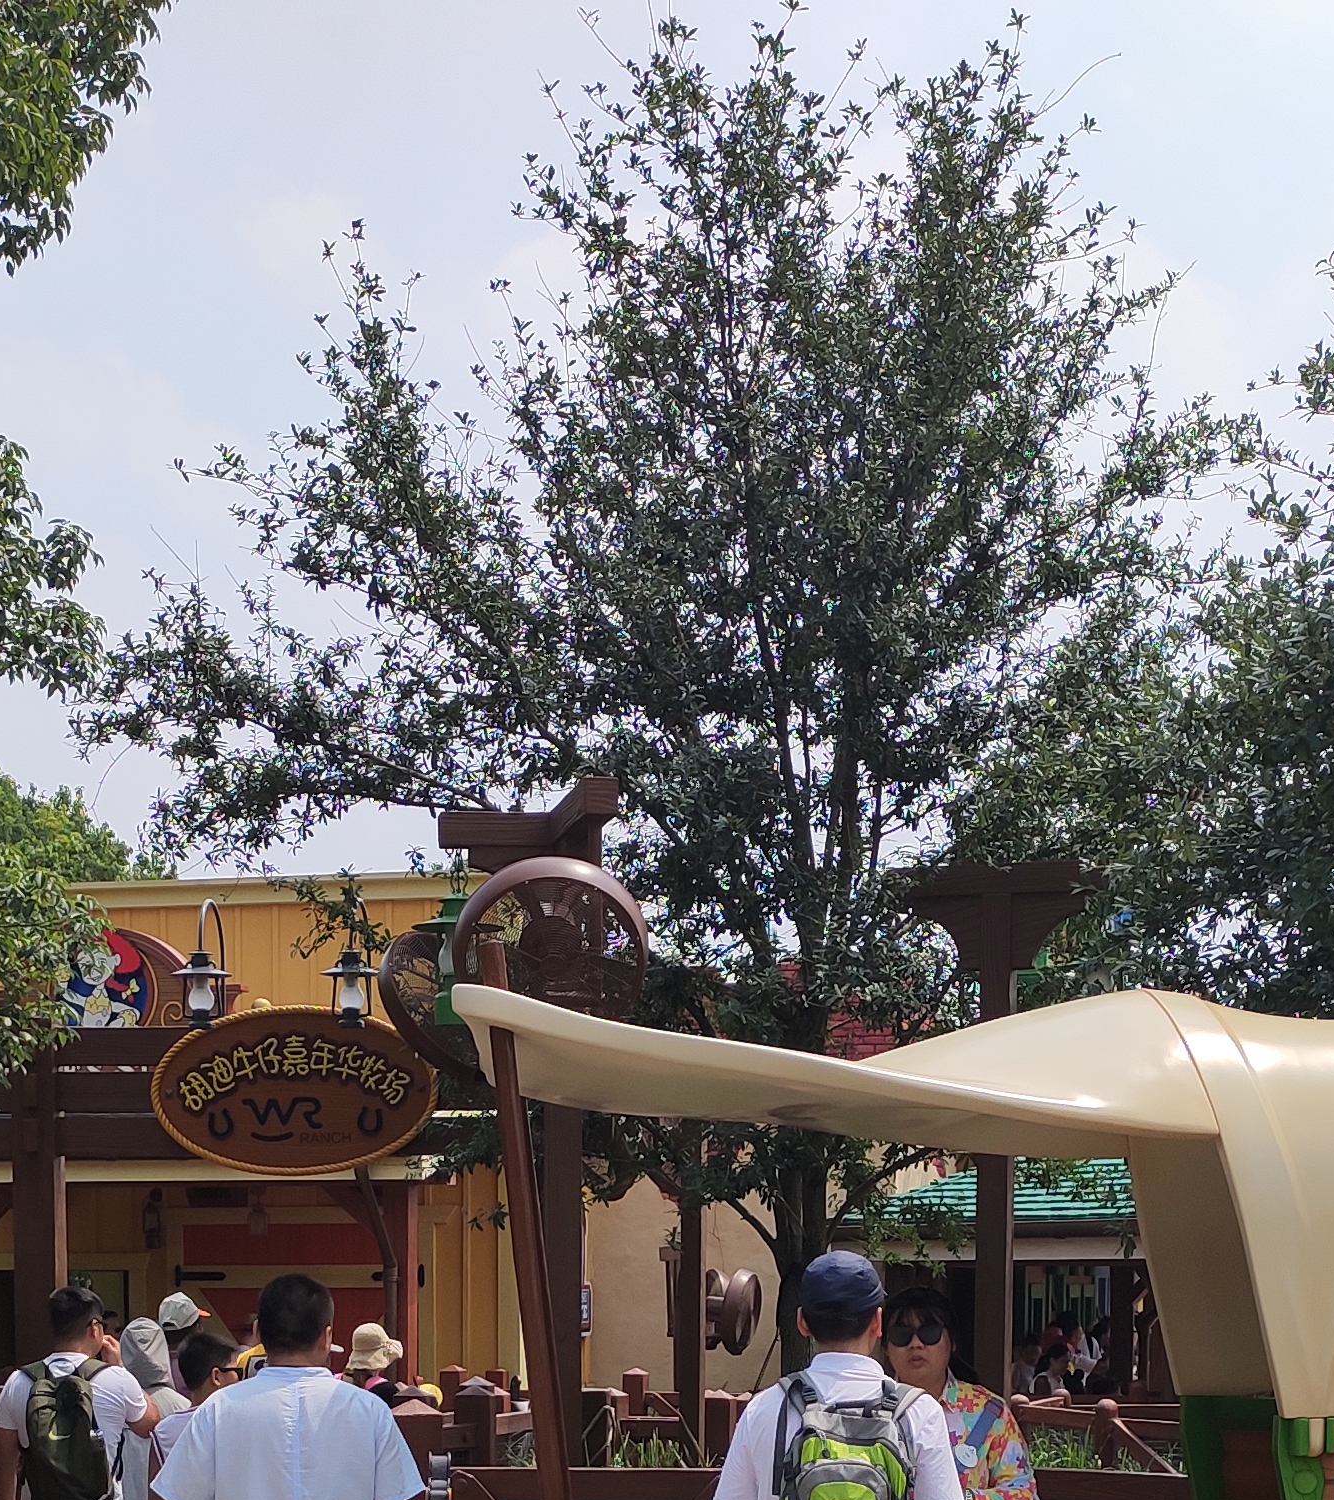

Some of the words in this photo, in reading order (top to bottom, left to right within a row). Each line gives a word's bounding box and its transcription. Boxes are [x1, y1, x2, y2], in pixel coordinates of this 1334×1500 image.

[180, 1035, 411, 1111] 胡迪牛仔嘉年华牧场
[300, 1132, 351, 1144] RANCH
